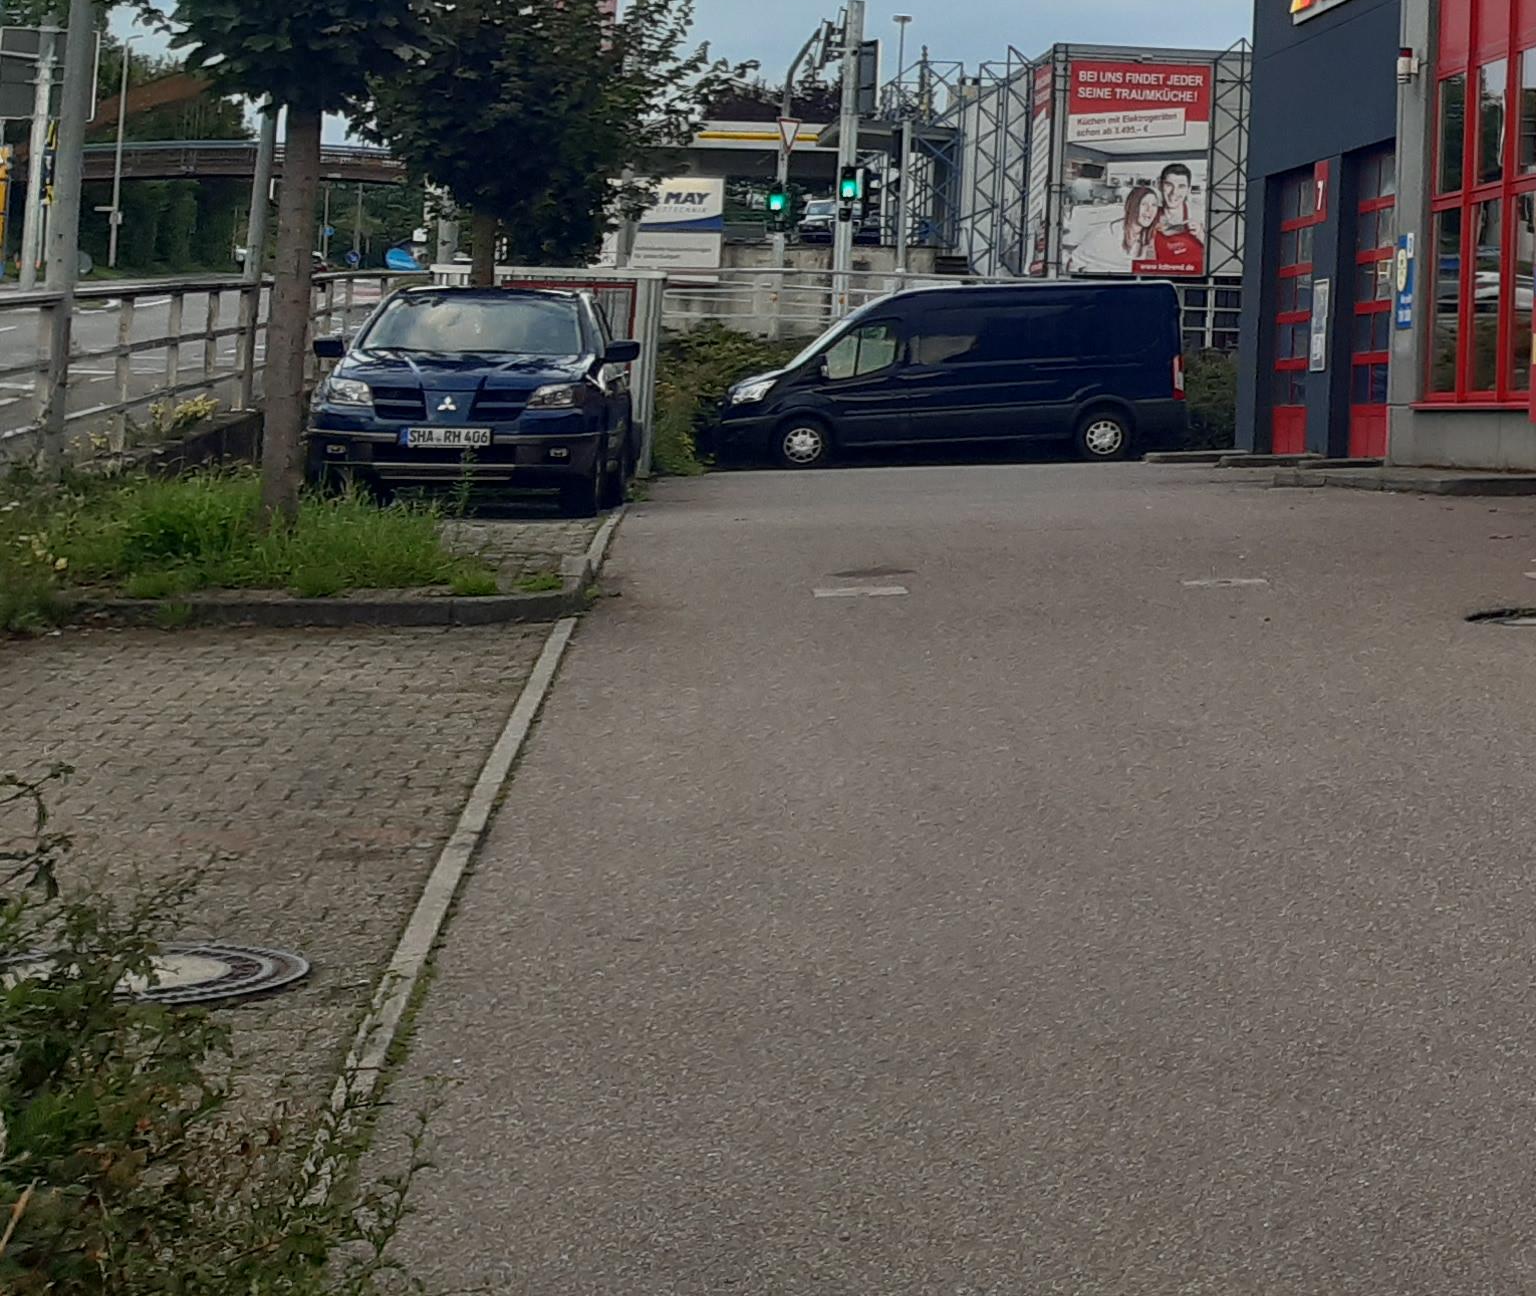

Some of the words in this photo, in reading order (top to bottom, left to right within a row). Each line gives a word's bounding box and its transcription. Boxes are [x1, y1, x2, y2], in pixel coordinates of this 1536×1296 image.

[1079, 71, 1097, 82] BEI
[1100, 71, 1123, 83] UNS
[1126, 73, 1165, 85] FINDET
[1167, 75, 1203, 86] JEDER
[1077, 87, 1112, 99] SEINE
[1115, 87, 1198, 102] TRAUMKÜCHE!
[664, 192, 711, 205] MAY
[409, 430, 433, 443] SHA
[443, 430, 461, 443] RH
[464, 430, 488, 444] 406
